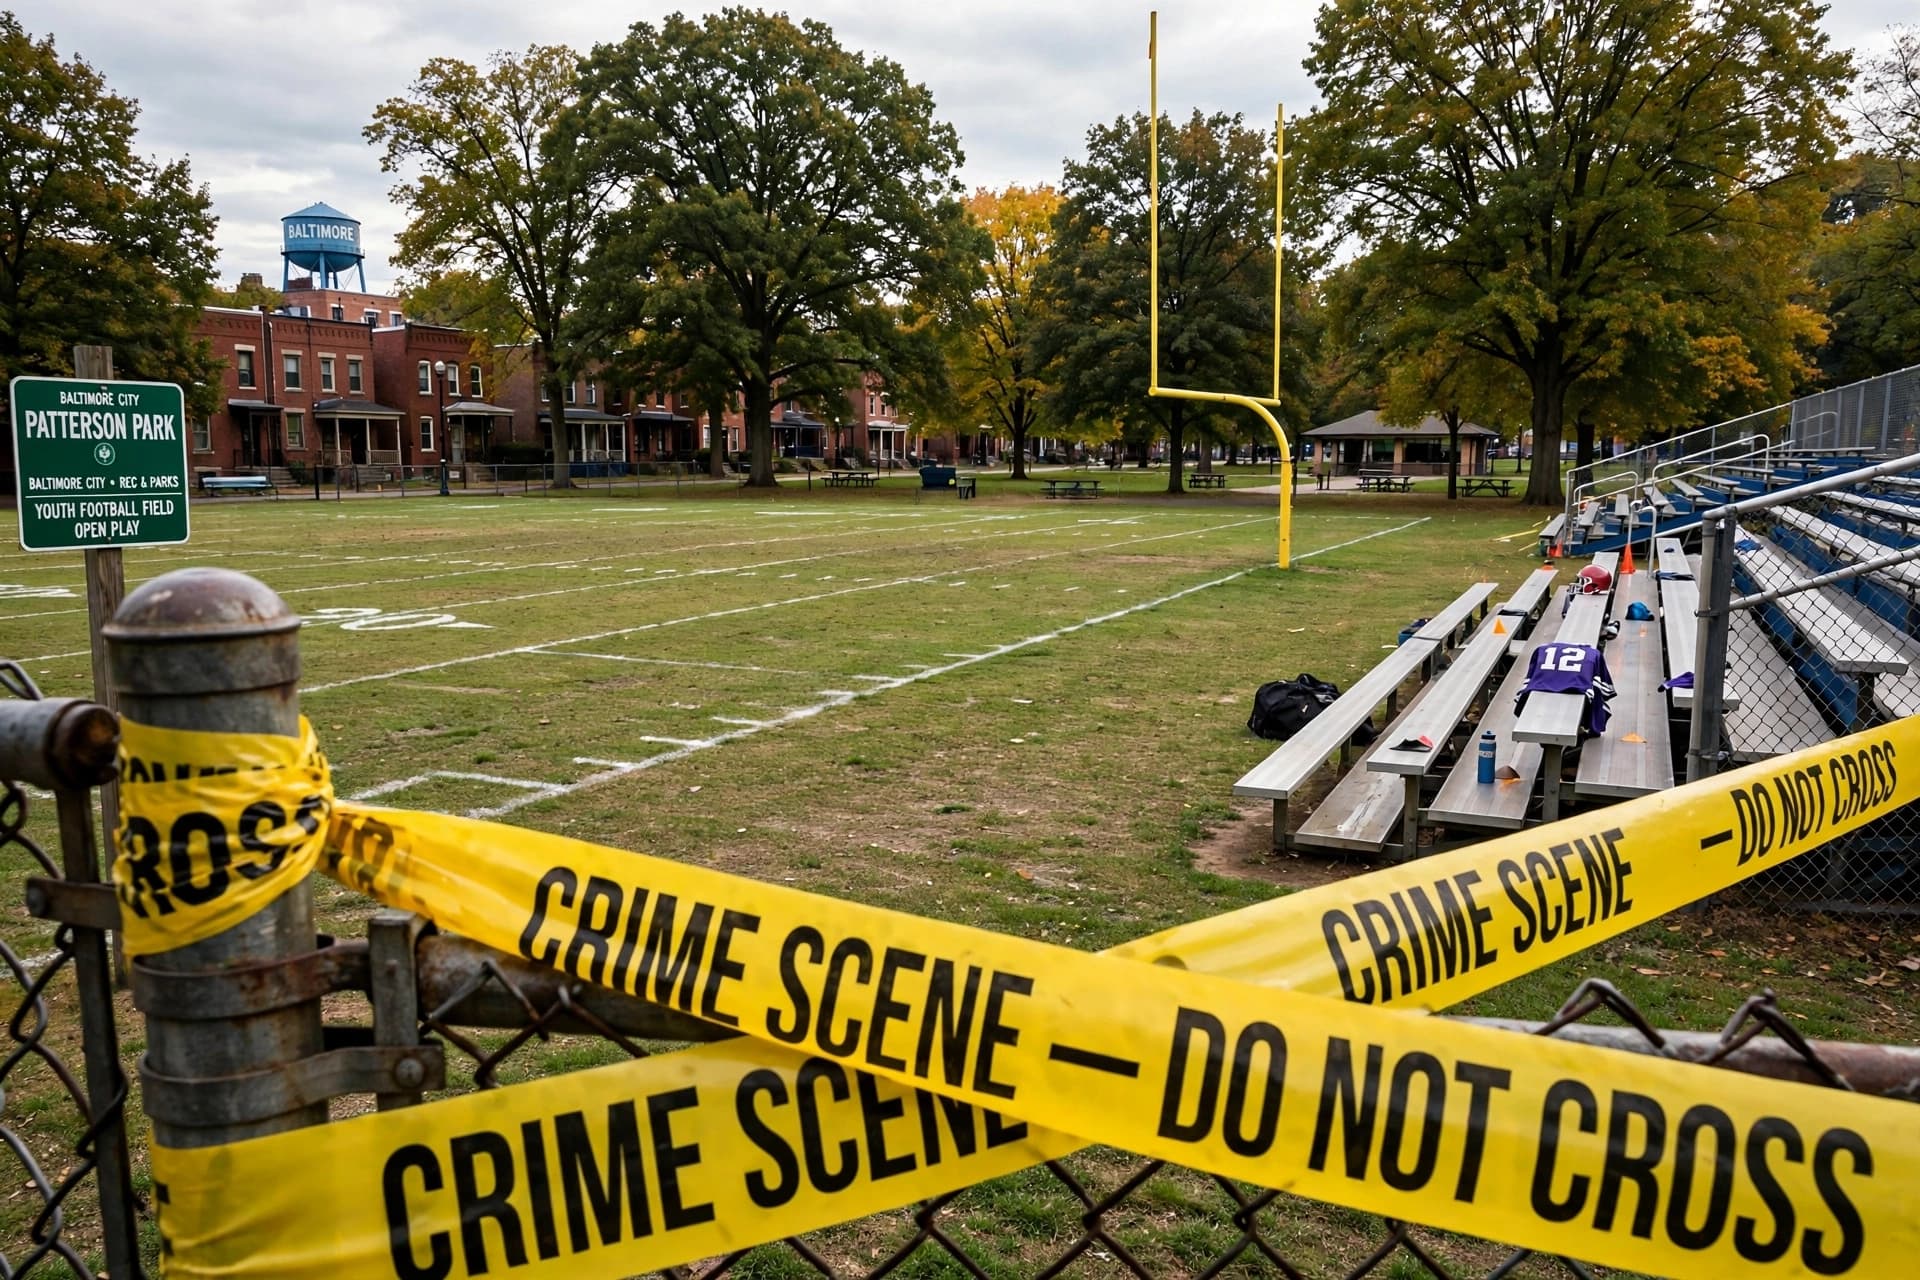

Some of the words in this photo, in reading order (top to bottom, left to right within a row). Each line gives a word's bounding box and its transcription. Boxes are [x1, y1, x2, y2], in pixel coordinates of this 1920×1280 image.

[288, 223, 354, 241] BALTIMORE
[60, 391, 114, 406] BALTIMORE
[118, 393, 139, 406] CITY
[25, 410, 127, 439] PATTERSON
[132, 413, 176, 440] PARK
[29, 477, 82, 490] BALTIMORE
[86, 478, 105, 489] CITY
[119, 477, 137, 489] REC
[141, 477, 147, 488] &
[150, 476, 179, 488] PARKS
[35, 503, 76, 519] YOUTH
[80, 502, 138, 518] FOOTBALL
[143, 500, 174, 515] FIELD
[75, 522, 106, 538] OPEN
[111, 520, 139, 536] PLAY
[1540, 647, 1585, 672] 12
[1731, 783, 1776, 865] DO
[1773, 764, 1825, 849] NOT
[1829, 740, 1897, 825] CROSS
[1322, 869, 1498, 1005] CRIME
[1498, 827, 1633, 953] SCENE
[519, 866, 760, 1026] CRIME
[766, 926, 1034, 1100] SCENE
[1157, 1006, 1287, 1159] DO
[1307, 1035, 1511, 1204] NOT
[1531, 1079, 1874, 1276] CROSS
[383, 1086, 715, 1280] CRIME
